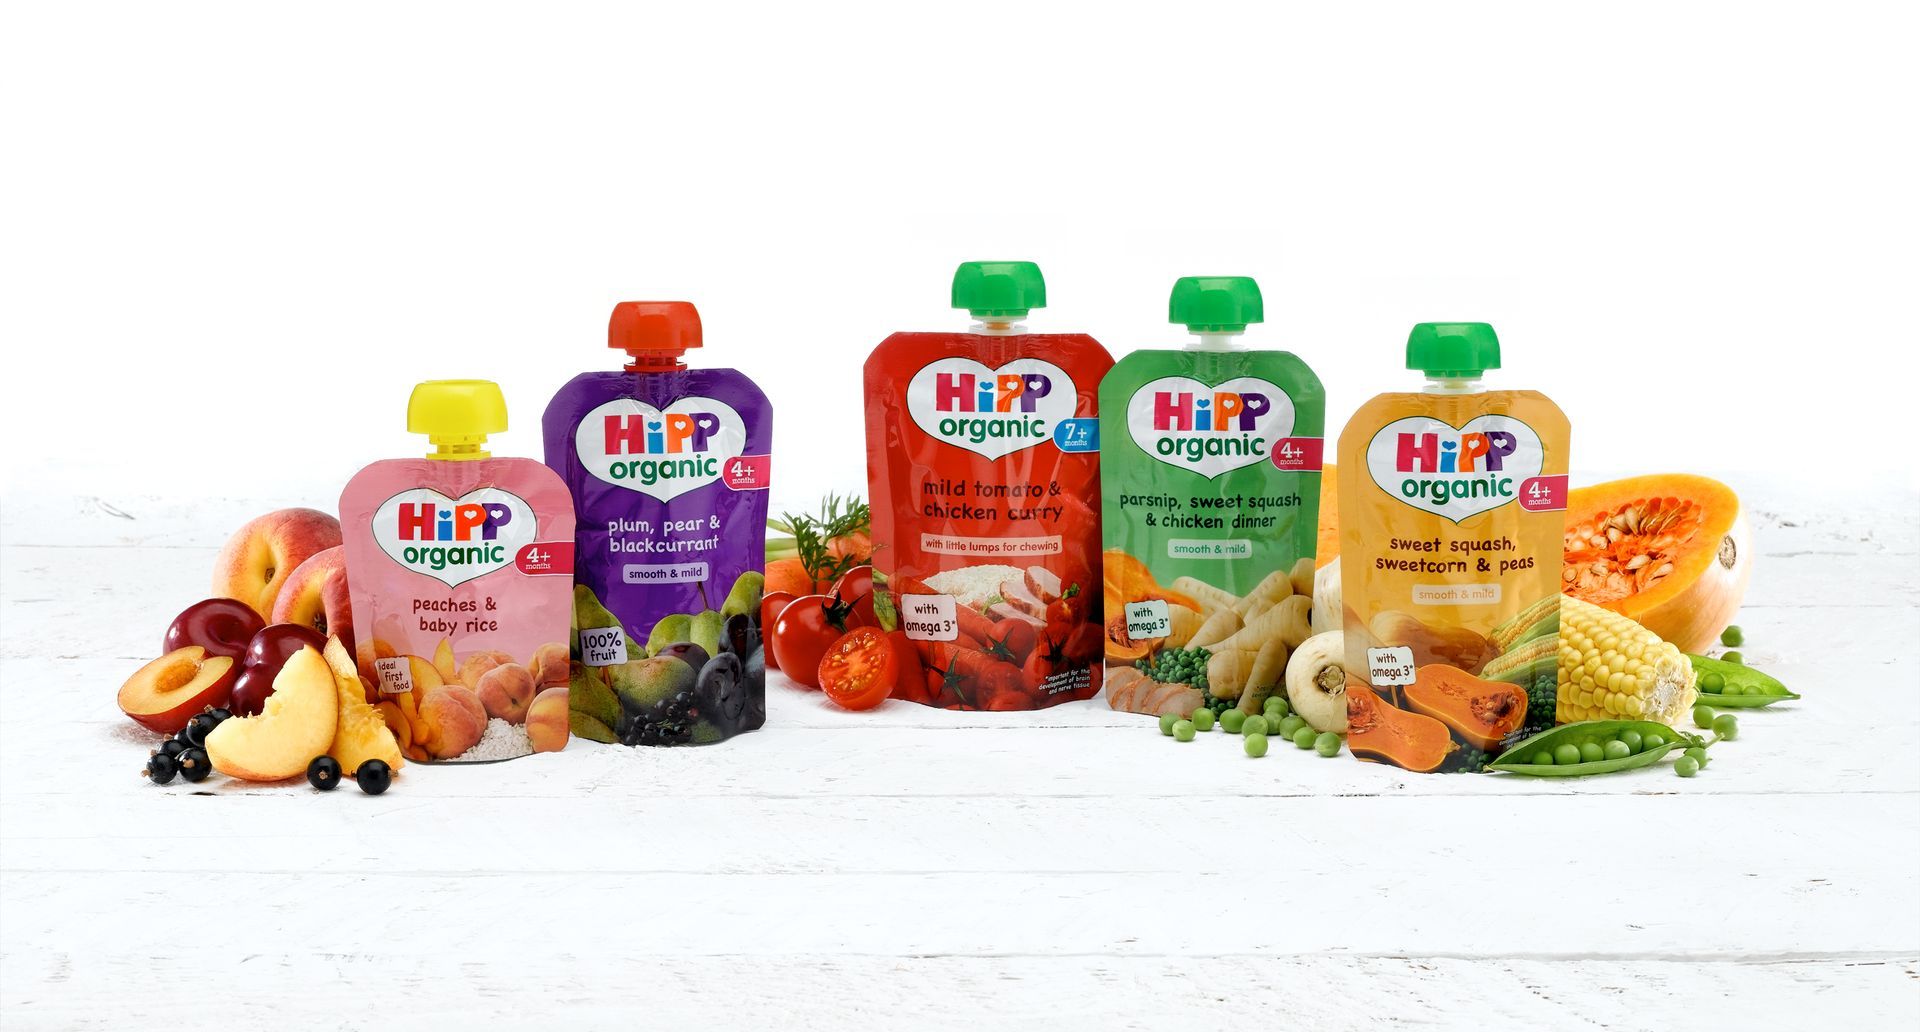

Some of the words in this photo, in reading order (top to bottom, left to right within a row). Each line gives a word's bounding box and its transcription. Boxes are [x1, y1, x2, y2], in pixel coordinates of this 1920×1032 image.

[936, 373, 1052, 413] HiPP
[1153, 392, 1271, 431] HiPP
[604, 412, 720, 455] HiPP
[939, 415, 1045, 444] organic
[1065, 423, 1088, 440] 7+
[1156, 433, 1265, 462] organic
[1280, 442, 1303, 459] 4+
[1396, 431, 1517, 473] HiPP
[609, 454, 717, 485] organic
[730, 461, 755, 477] 4+
[732, 477, 755, 485] months
[923, 479, 966, 497] mild
[974, 481, 1043, 497] tomato
[1048, 481, 1061, 496] &
[1401, 474, 1513, 505] organic
[1528, 482, 1551, 498] 4+
[1120, 493, 1182, 510] parsnip,
[1190, 494, 1243, 508] sweet
[1248, 493, 1301, 511] squash
[923, 502, 997, 520] chicken
[1007, 505, 1063, 523] curry
[1146, 514, 1157, 526] &
[1162, 513, 1223, 529] chicken
[1231, 514, 1276, 528] dinner
[399, 503, 512, 541] HiPP
[608, 517, 654, 536] plum,
[663, 517, 704, 536] pear
[709, 515, 720, 529] &
[609, 534, 719, 553] blackcurrant
[925, 538, 943, 549] with
[945, 539, 967, 551] little
[969, 541, 1000, 554] lumps
[1002, 541, 1017, 552] for
[1019, 540, 1059, 552] chewing
[1174, 544, 1211, 554] smooth
[1214, 545, 1222, 554] &
[1225, 544, 1246, 554] mild
[1390, 537, 1441, 552] sweet
[1450, 536, 1516, 556] squash,
[403, 542, 504, 570] organic
[526, 547, 551, 563] 4+
[629, 568, 667, 580] smooth
[670, 569, 678, 578] &
[681, 567, 702, 578] mild
[1376, 556, 1467, 574] sweetcorn
[1476, 559, 1490, 572] &
[1500, 556, 1534, 575] peas
[1419, 589, 1457, 599] smooth
[1461, 589, 1469, 599] &
[1472, 588, 1495, 599] mild
[413, 598, 477, 614] peaches
[485, 597, 497, 610] &
[914, 603, 939, 614] with
[1133, 608, 1153, 618] with
[419, 617, 457, 636] baby
[466, 617, 498, 632] rice
[906, 622, 941, 636] omega
[1128, 622, 1157, 634] omega
[583, 631, 622, 649] 100%
[590, 648, 617, 661] fruit
[1376, 653, 1397, 663] with
[378, 661, 396, 670] ideal
[1372, 668, 1402, 680] omega
[385, 671, 403, 681] first
[393, 681, 409, 690] food
